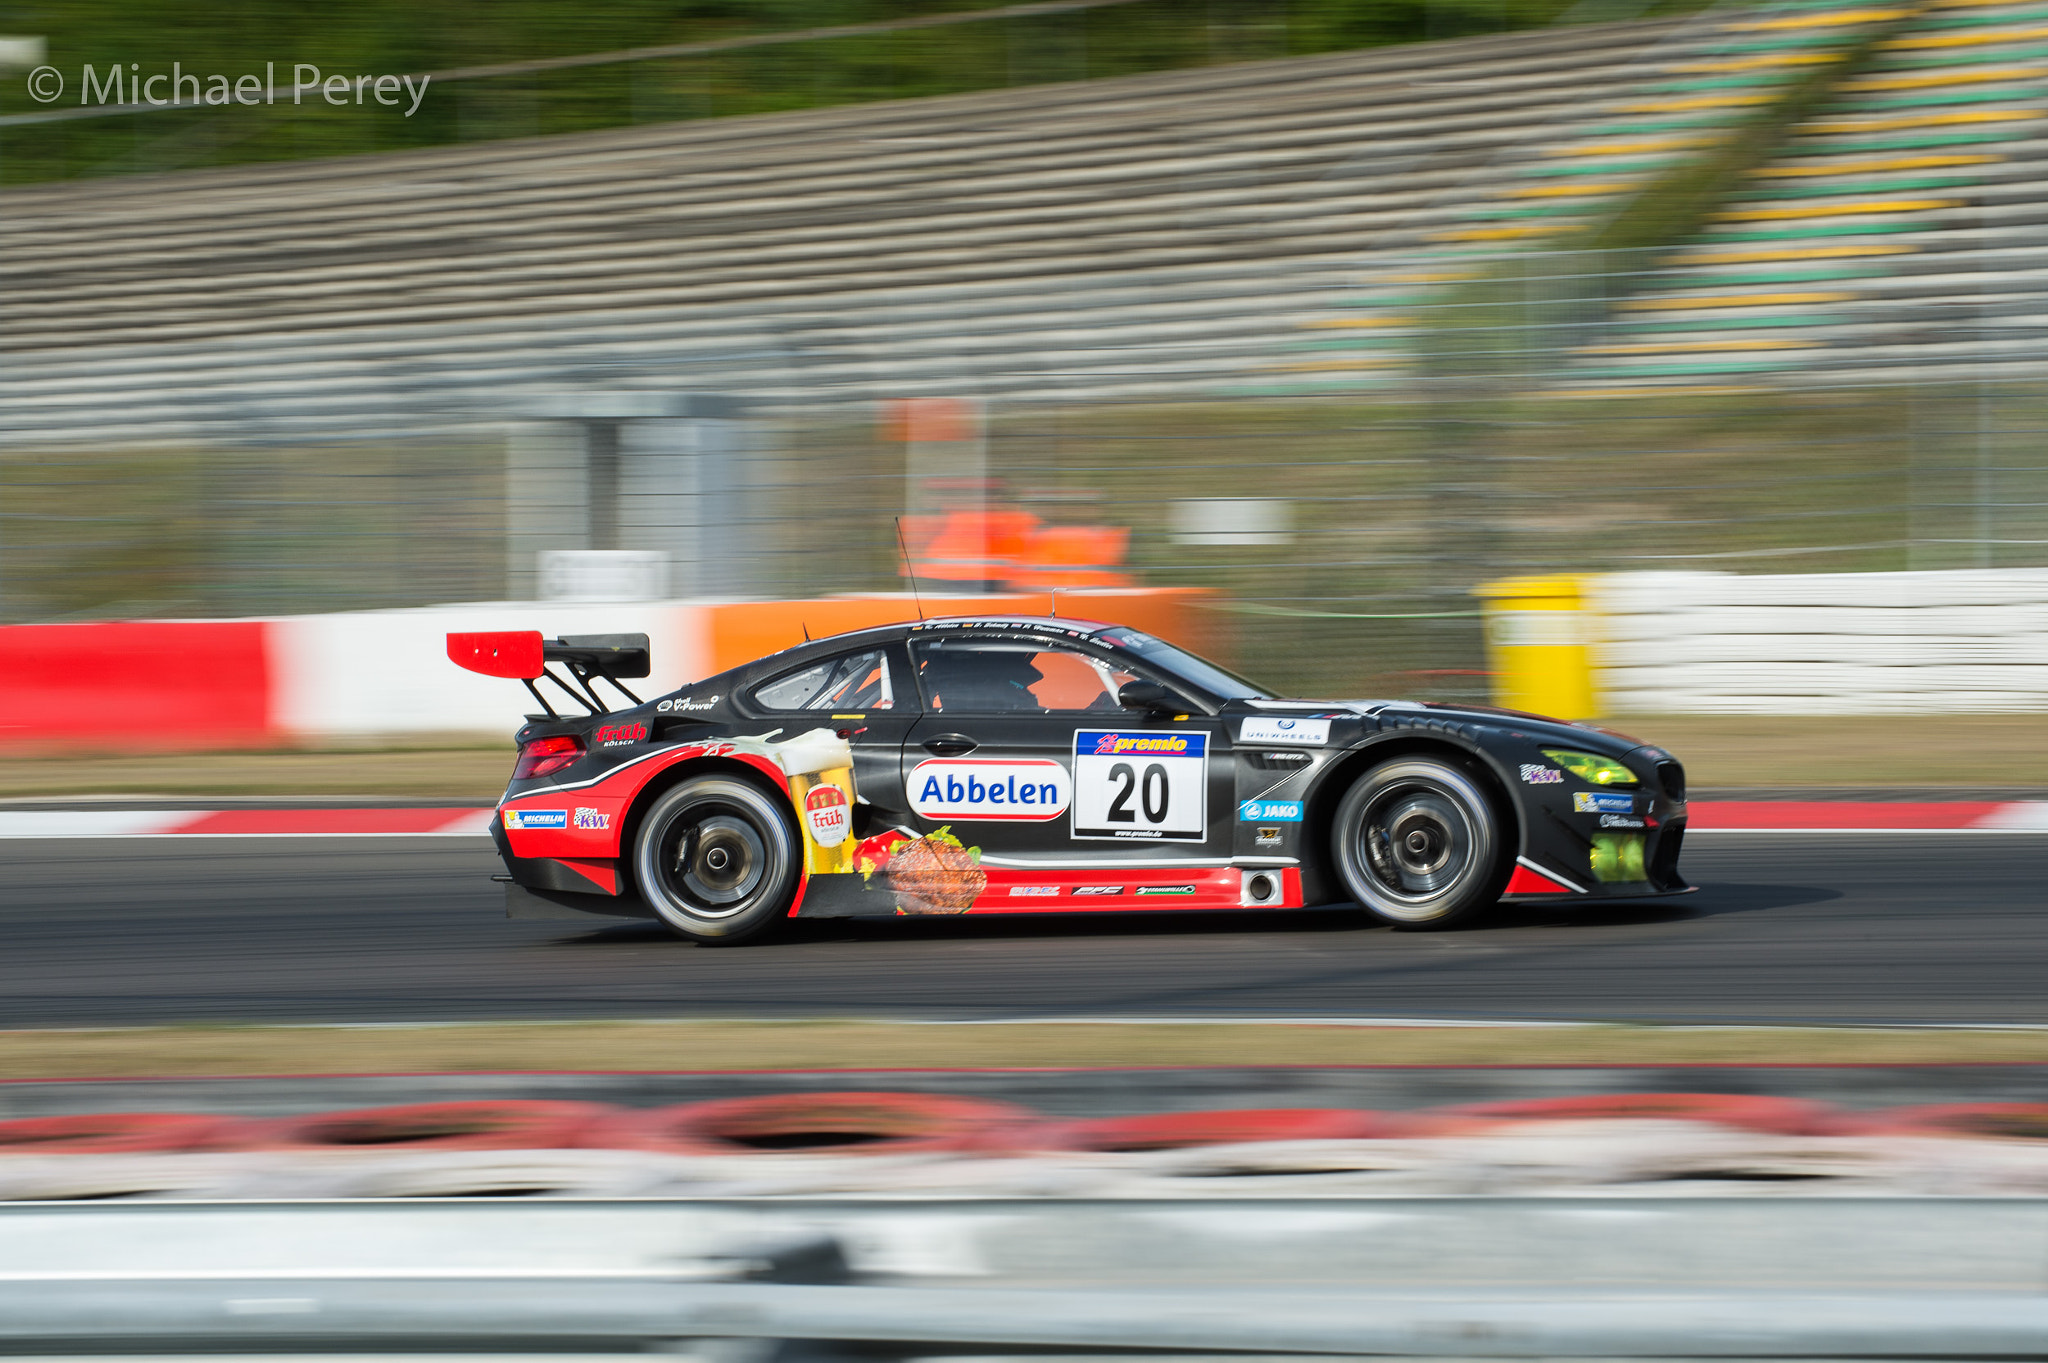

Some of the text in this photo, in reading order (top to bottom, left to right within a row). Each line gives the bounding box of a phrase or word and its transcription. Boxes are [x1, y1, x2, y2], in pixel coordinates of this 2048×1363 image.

[674, 702, 715, 712] V-Power
[595, 721, 647, 743] früh
[1113, 736, 1188, 754] premio
[919, 774, 1058, 805] Abbelen
[1106, 762, 1170, 824] 20
[523, 814, 566, 823] MICHELIN
[813, 808, 844, 828] früh
[1262, 804, 1299, 818] JAKO
